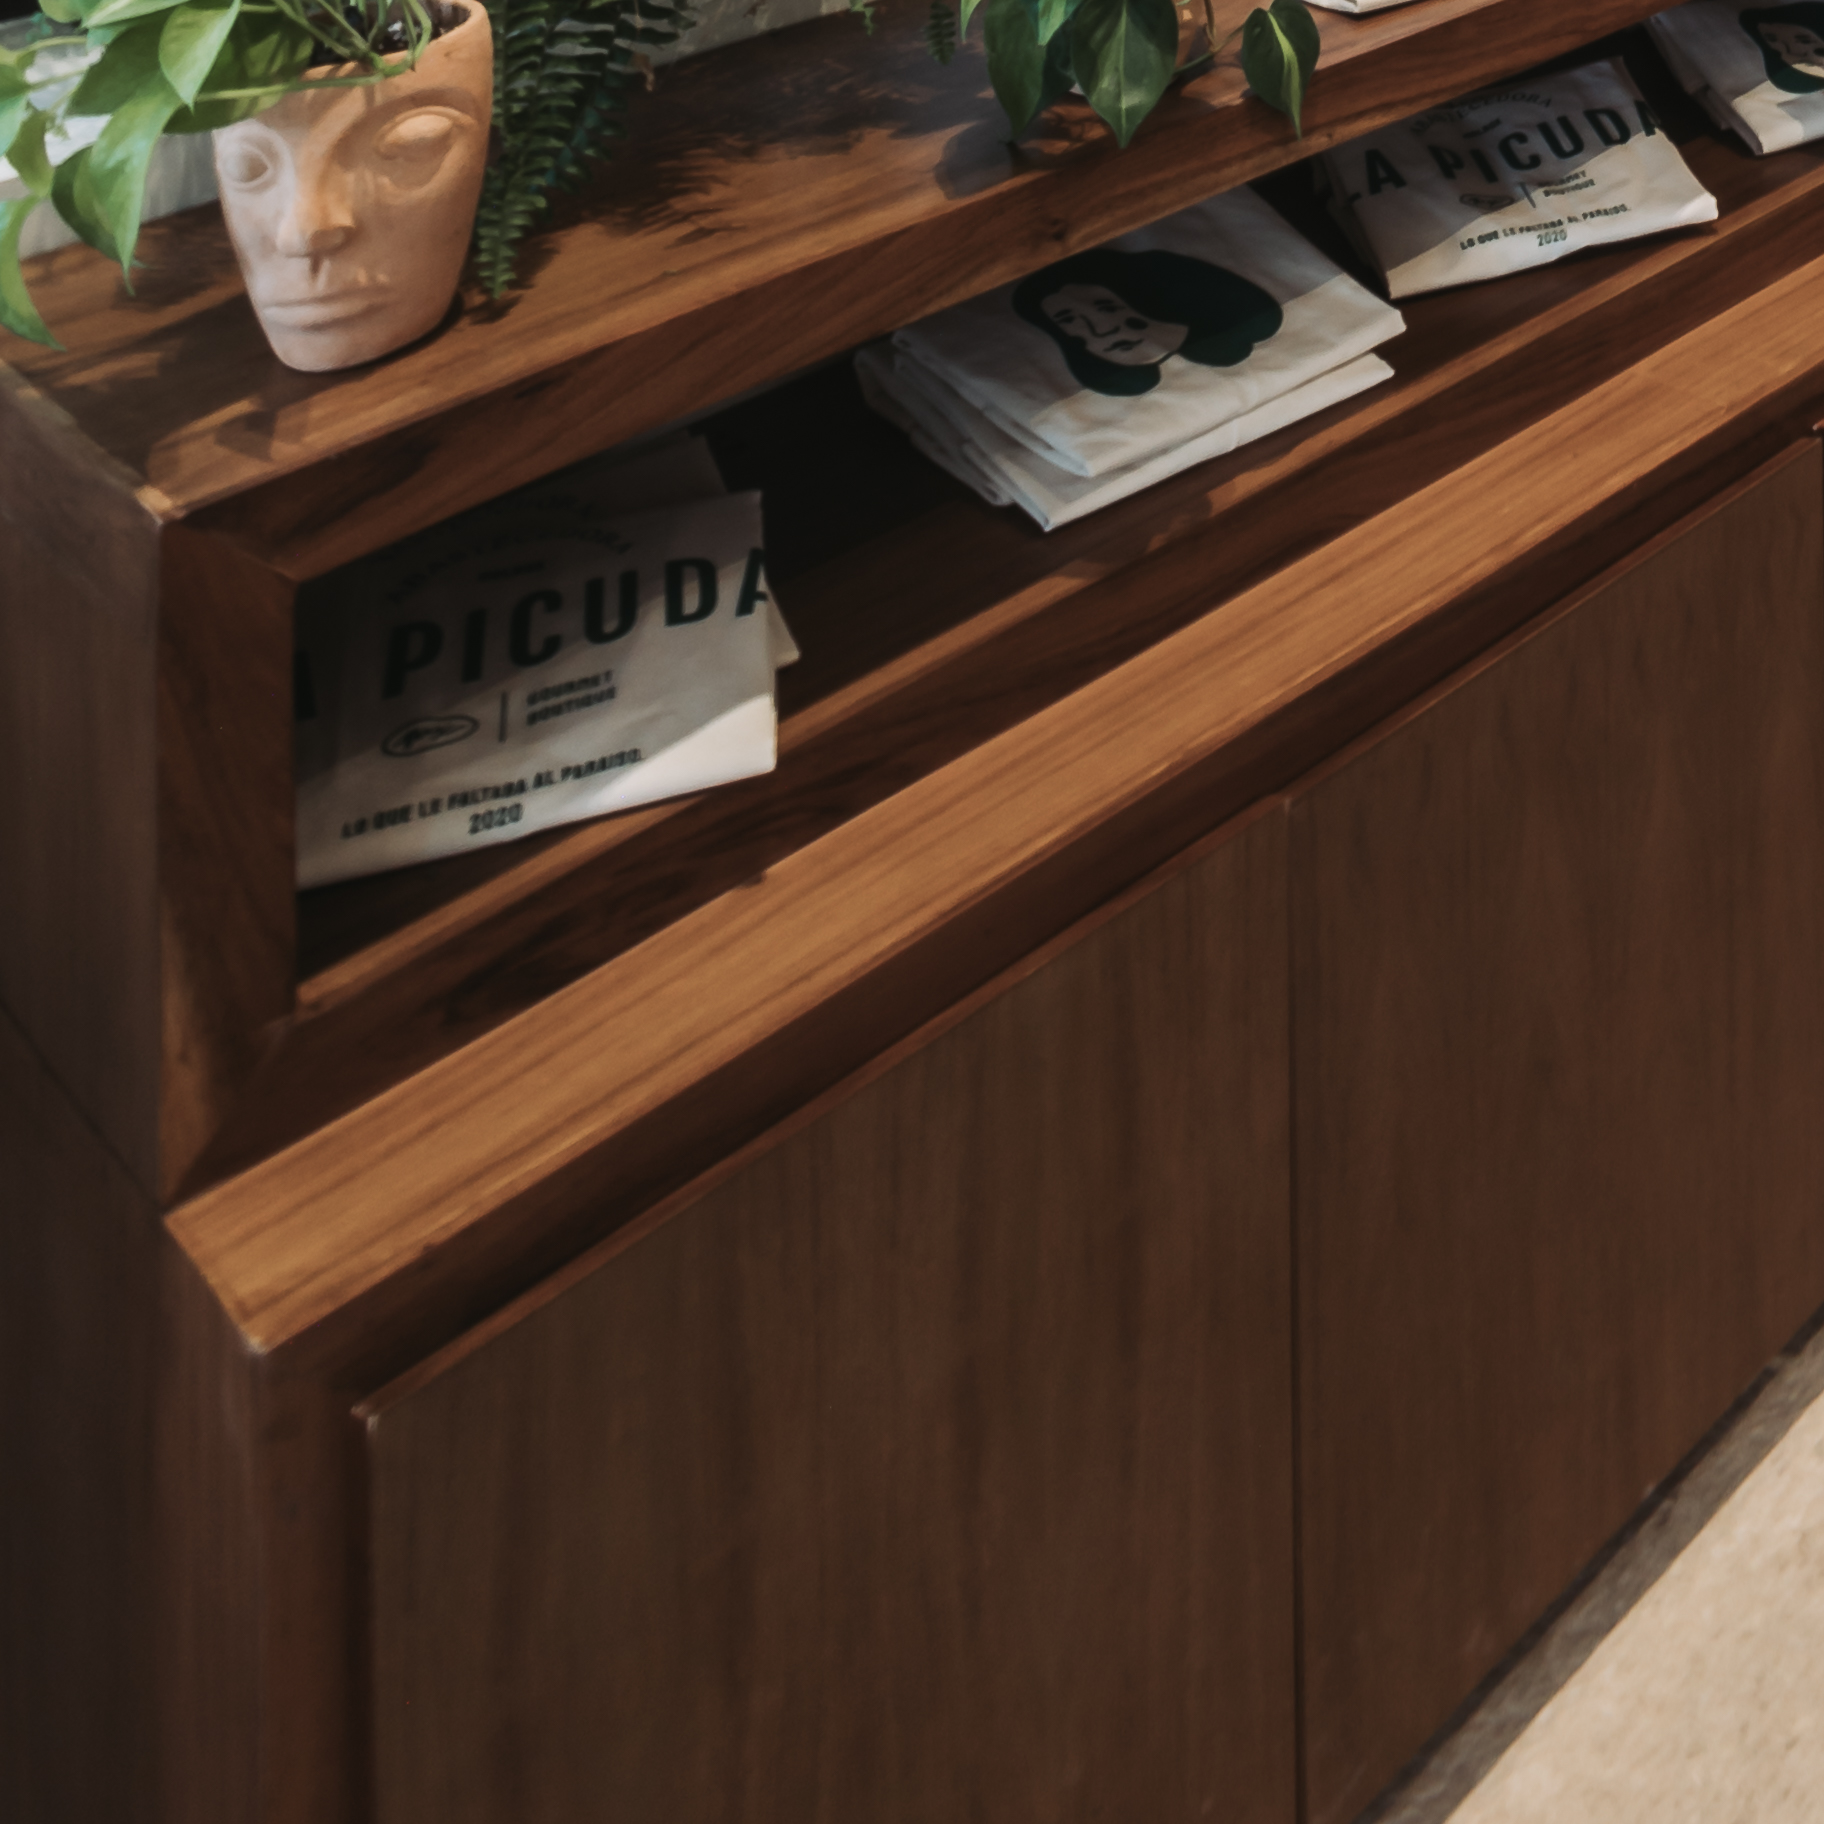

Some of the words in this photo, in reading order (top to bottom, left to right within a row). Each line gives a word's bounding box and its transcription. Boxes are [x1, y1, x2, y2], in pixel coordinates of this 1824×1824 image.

[1536, 228, 1568, 247] 2020
[526, 669, 615, 707] GOURMET
[526, 686, 617, 726] BOUTIQUE
[340, 817, 367, 839] LO
[373, 804, 412, 830] QUE
[418, 797, 443, 818] LE
[467, 802, 524, 836] 2020
